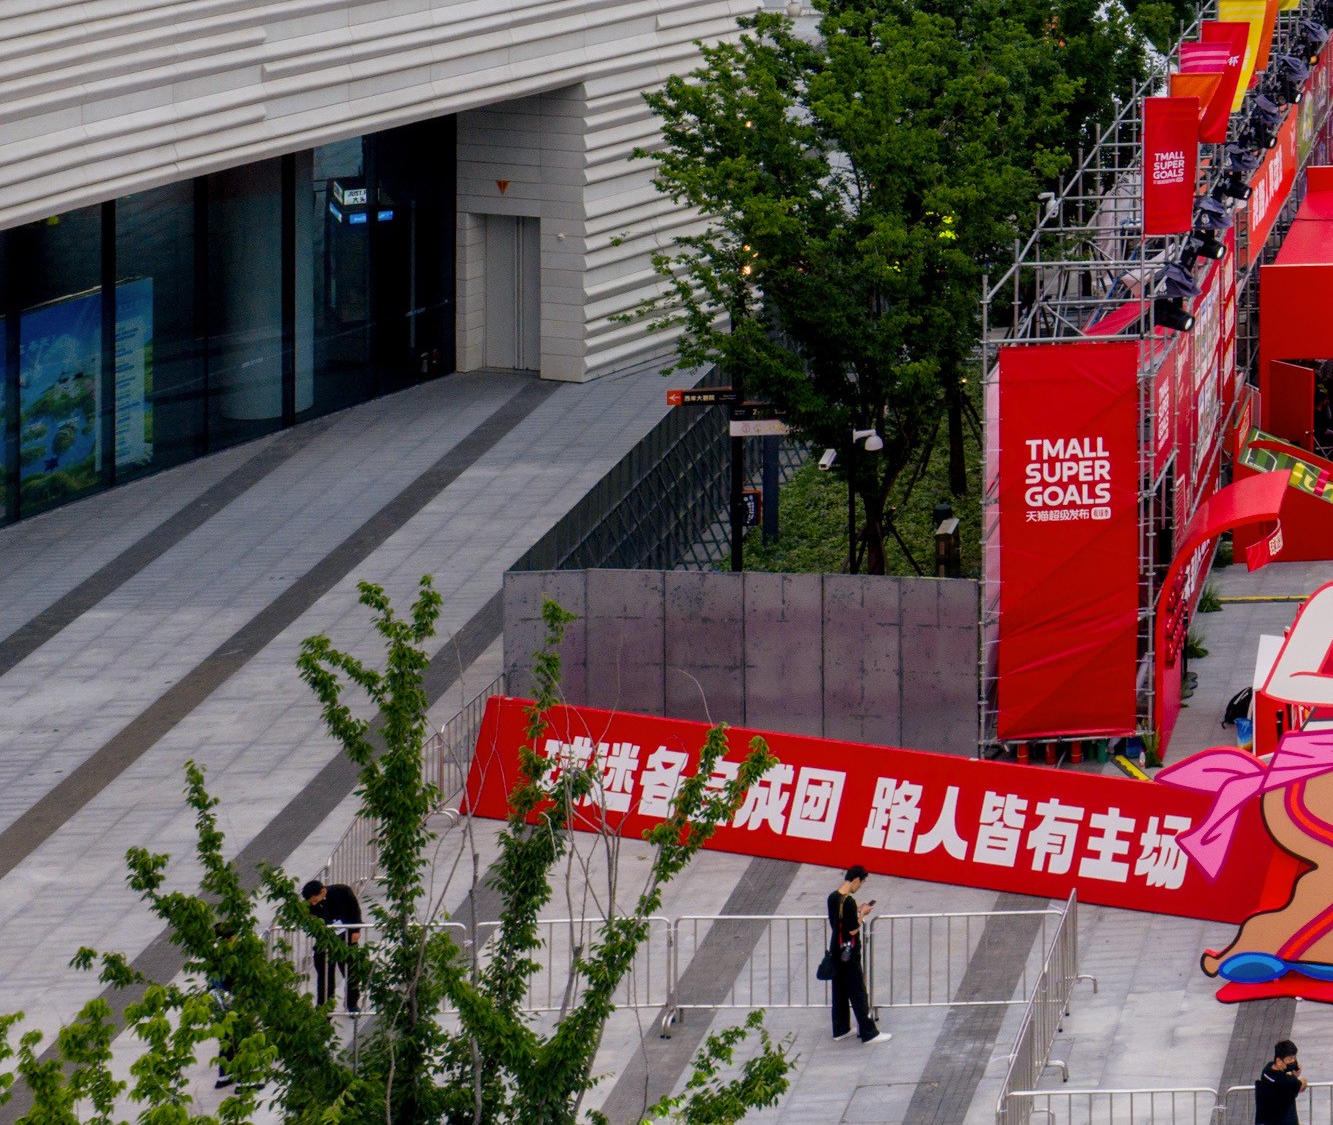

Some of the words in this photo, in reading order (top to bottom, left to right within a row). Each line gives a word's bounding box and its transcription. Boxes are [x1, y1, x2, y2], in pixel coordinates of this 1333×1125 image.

[1153, 160, 1185, 171] SUPER
[1154, 151, 1185, 162] TMALL
[1153, 168, 1184, 180] GOALS
[1025, 437, 1110, 461] TMALL
[1025, 460, 1111, 485] SUPER
[1024, 484, 1111, 507] GOALS
[1025, 508, 1090, 523] 天猫超级发布
[860, 776, 1193, 891] 路人皆有主场
